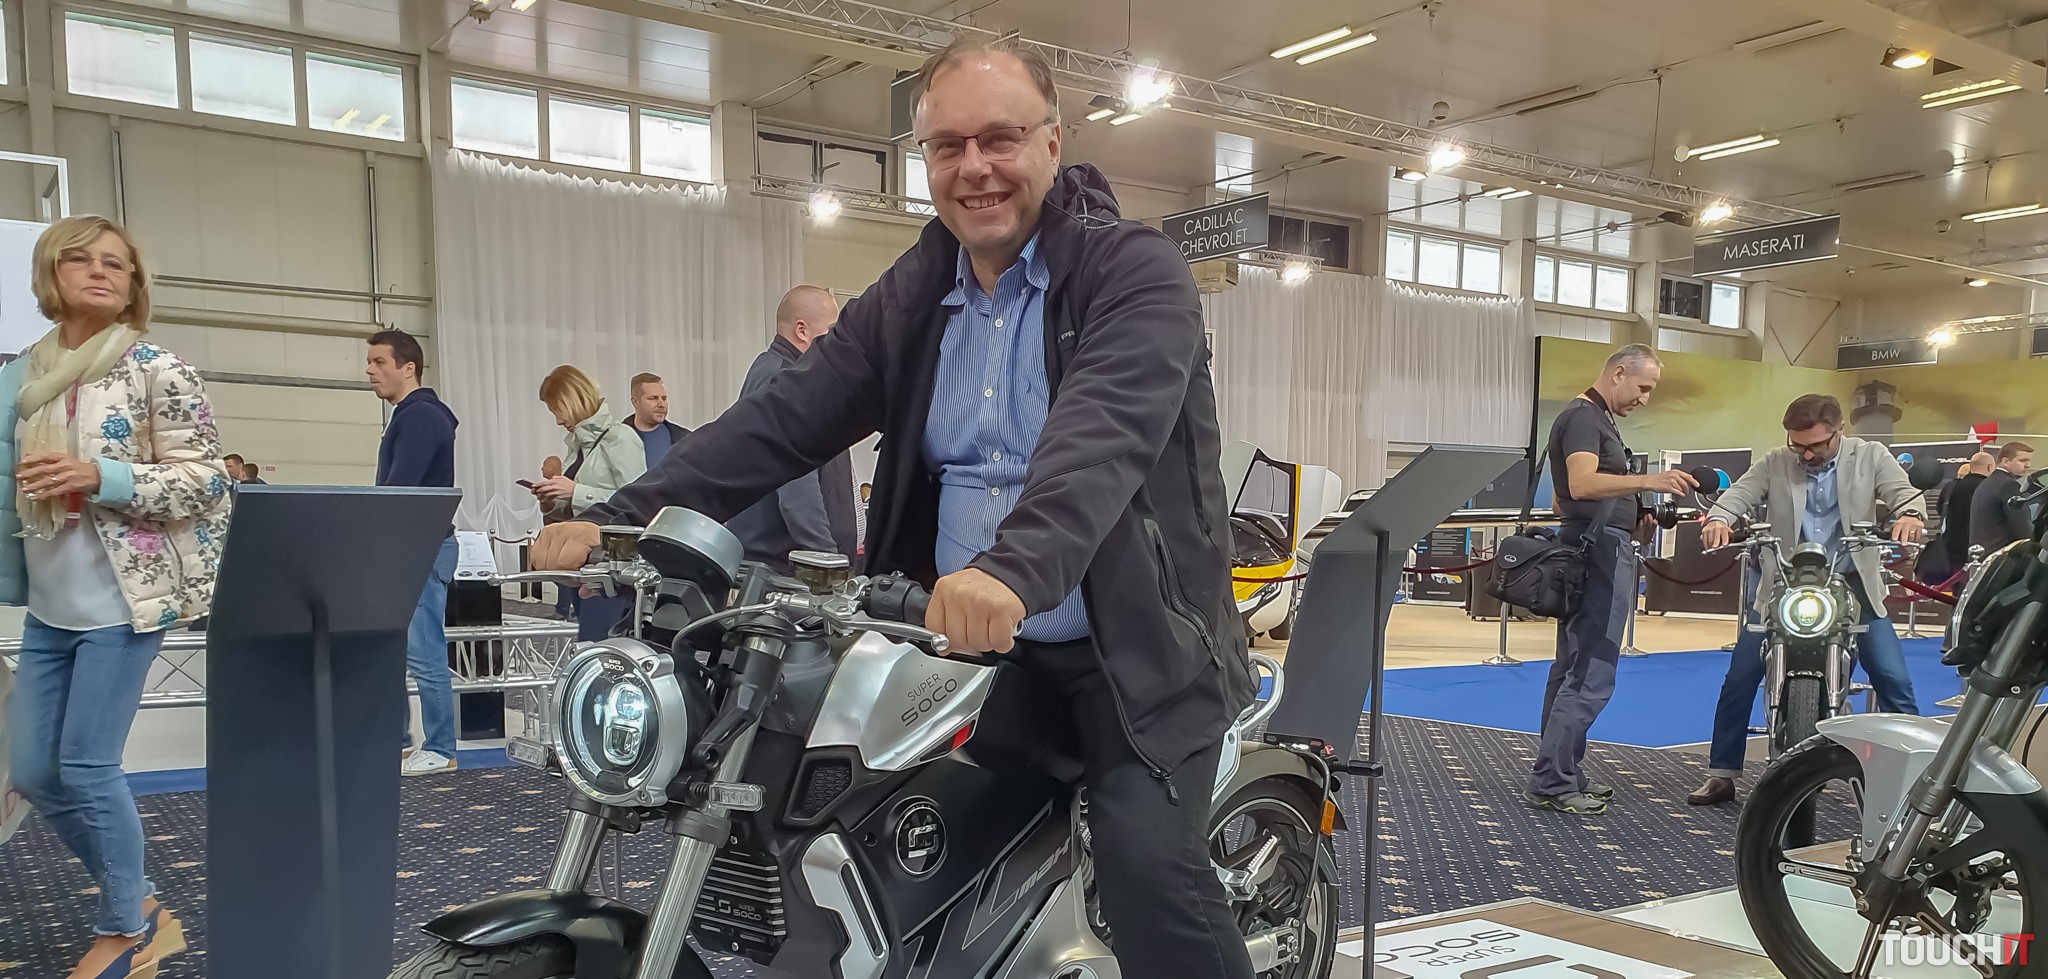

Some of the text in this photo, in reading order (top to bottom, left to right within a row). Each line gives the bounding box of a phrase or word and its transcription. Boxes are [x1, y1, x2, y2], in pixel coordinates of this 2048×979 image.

[1184, 208, 1244, 235] CADILLAC
[1180, 228, 1248, 256] CHEVROLET
[1723, 234, 1805, 260] MASERATI
[1871, 349, 1901, 361] BMW
[907, 673, 942, 702] SUPER
[901, 678, 958, 727] SOCO
[732, 908, 762, 921] SOCO
[1418, 945, 1516, 967] SUPER
